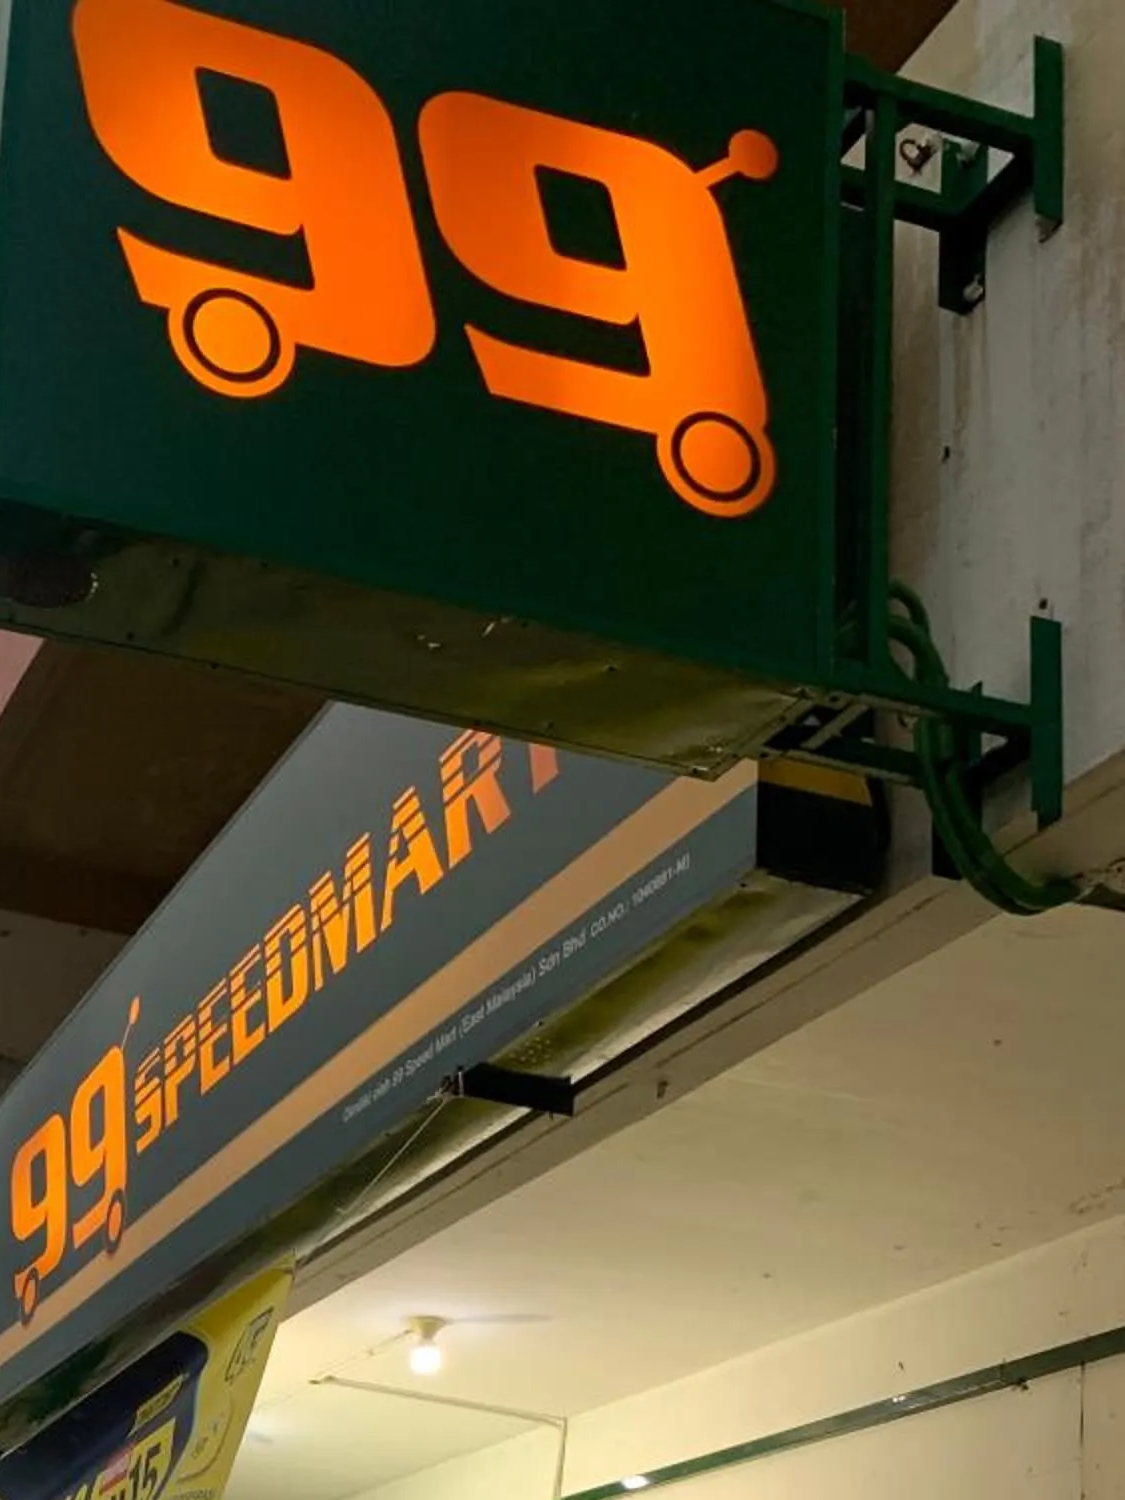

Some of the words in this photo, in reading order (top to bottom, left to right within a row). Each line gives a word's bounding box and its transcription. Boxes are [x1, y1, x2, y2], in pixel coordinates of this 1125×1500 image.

[72, 0, 775, 518] 99
[538, 948, 562, 976] Sdn
[562, 930, 587, 961] Bhd
[10, 1010, 139, 1320] 99
